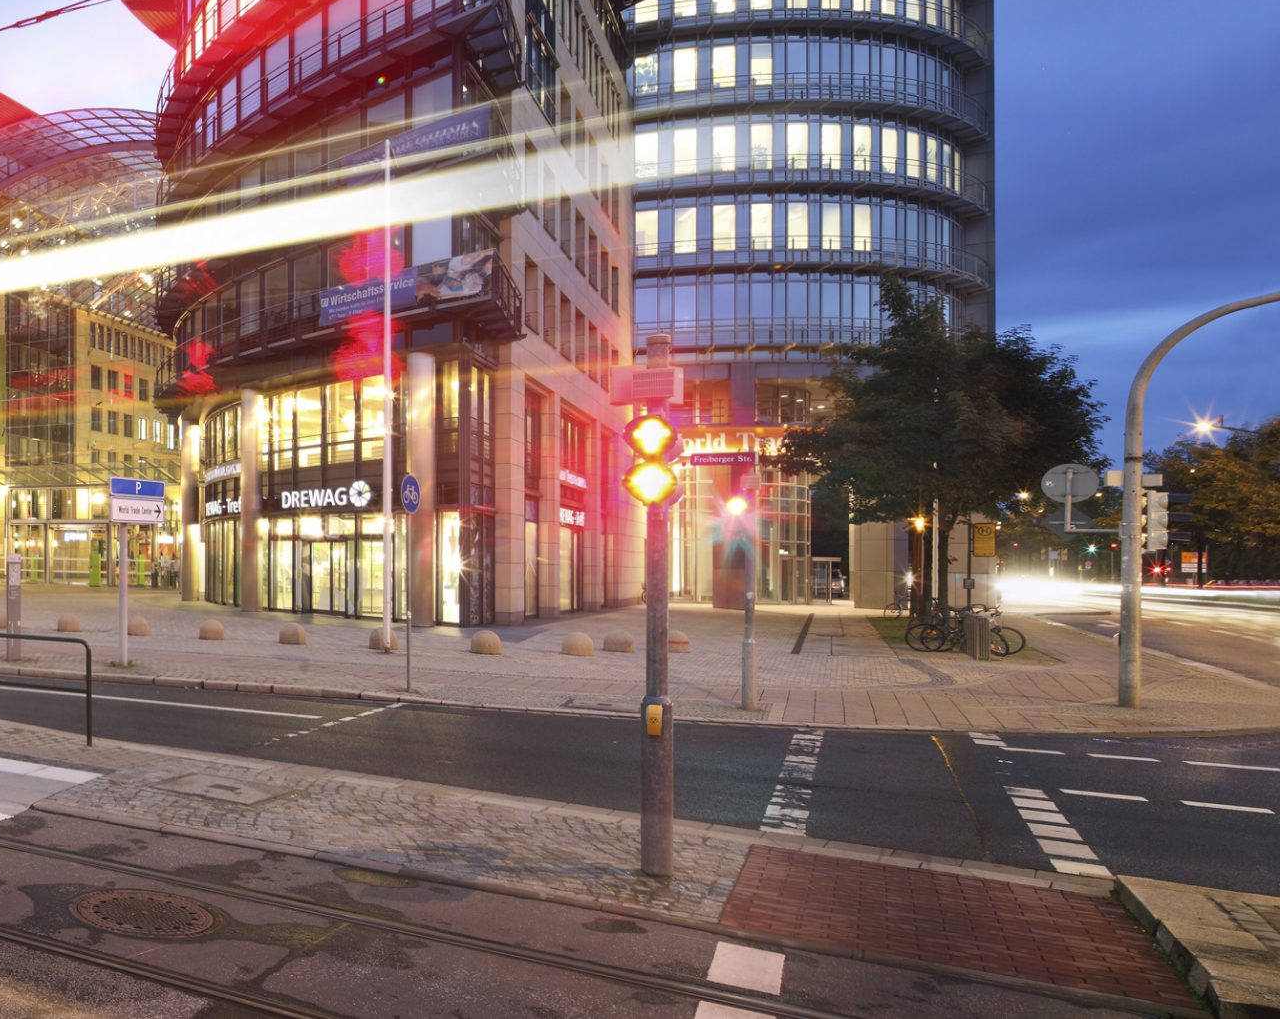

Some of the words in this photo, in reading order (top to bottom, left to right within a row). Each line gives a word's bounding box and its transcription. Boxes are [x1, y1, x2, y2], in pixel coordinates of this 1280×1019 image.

[330, 278, 415, 306] Wirtschaftssrvice
[677, 432, 727, 454] orld
[693, 455, 736, 464] Freiberger
[737, 454, 753, 463] Str.
[135, 481, 142, 495] P
[281, 486, 348, 509] DREWAG
[118, 506, 130, 514] World
[131, 506, 140, 515] Trade
[141, 507, 153, 515] Center
